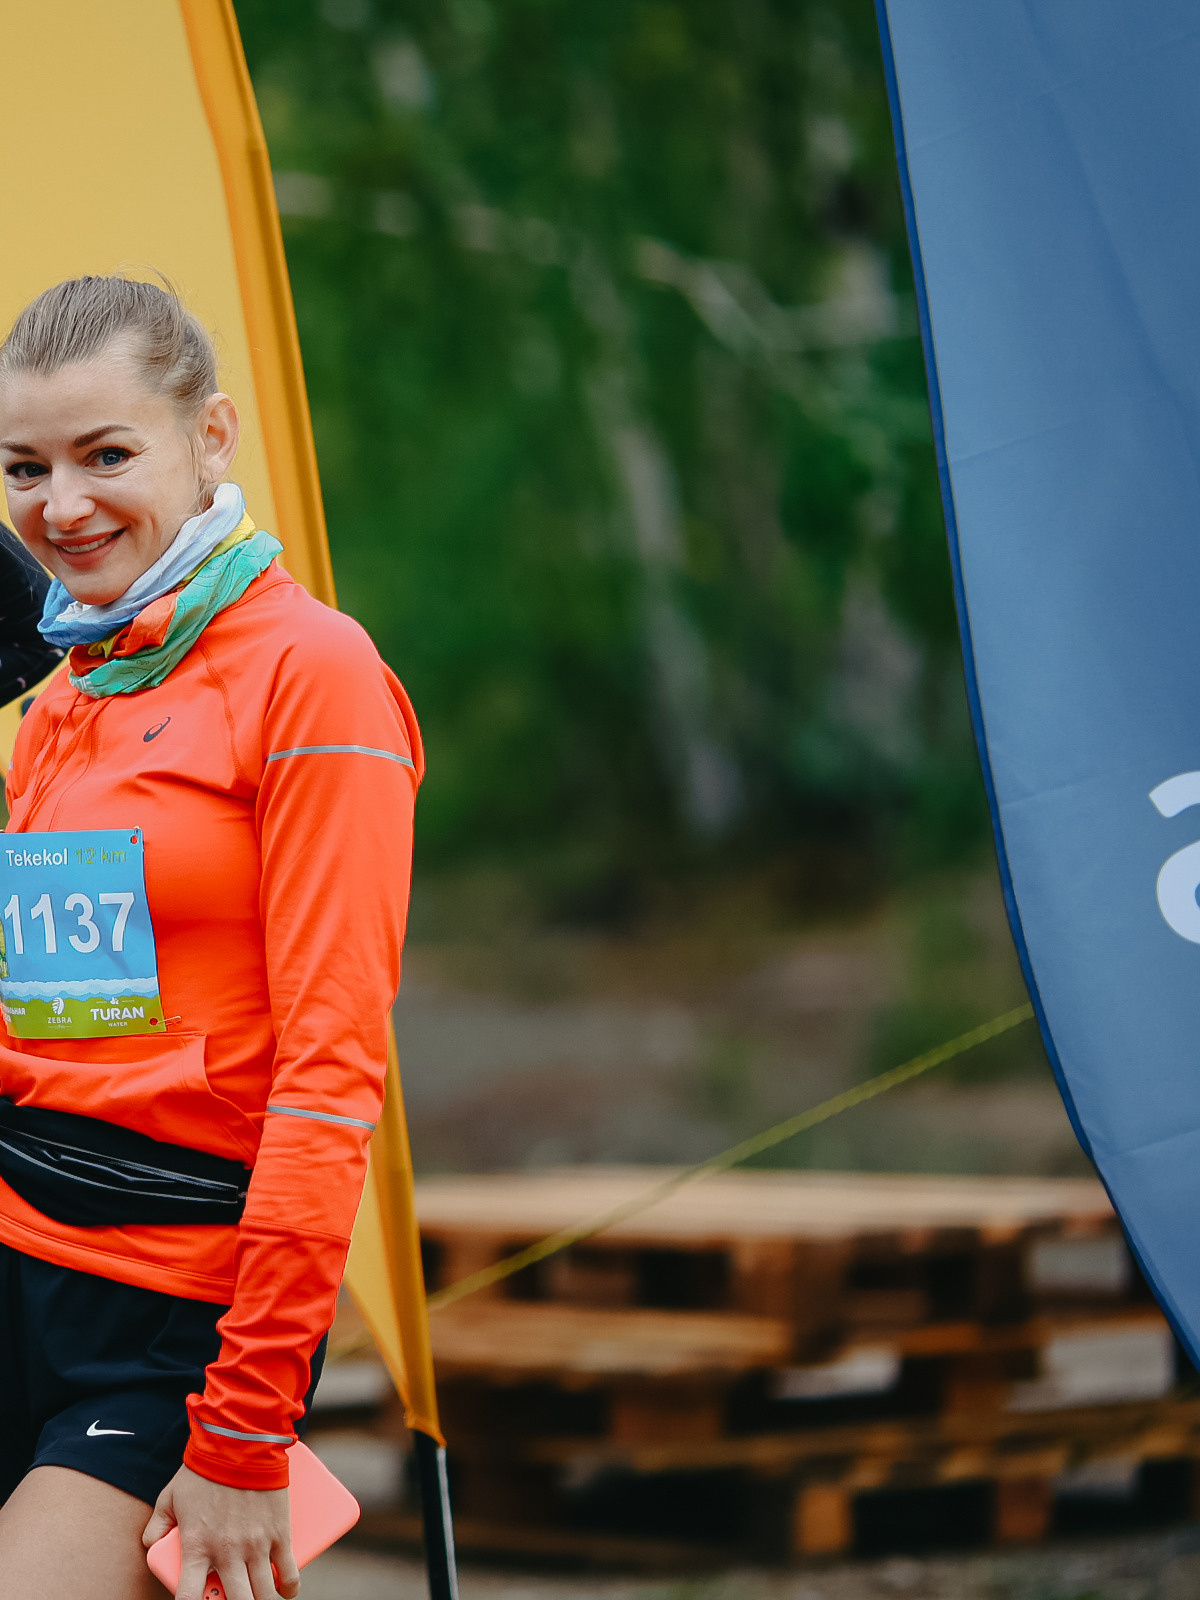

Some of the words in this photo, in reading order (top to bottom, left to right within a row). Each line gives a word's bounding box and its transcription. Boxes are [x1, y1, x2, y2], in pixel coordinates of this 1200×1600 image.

[5, 848, 68, 867] Tekekol
[75, 847, 96, 865] 12
[100, 847, 126, 864] km
[4, 891, 135, 955] 1137
[47, 1016, 73, 1024] ZEBRA
[90, 1006, 145, 1021] TURAN
